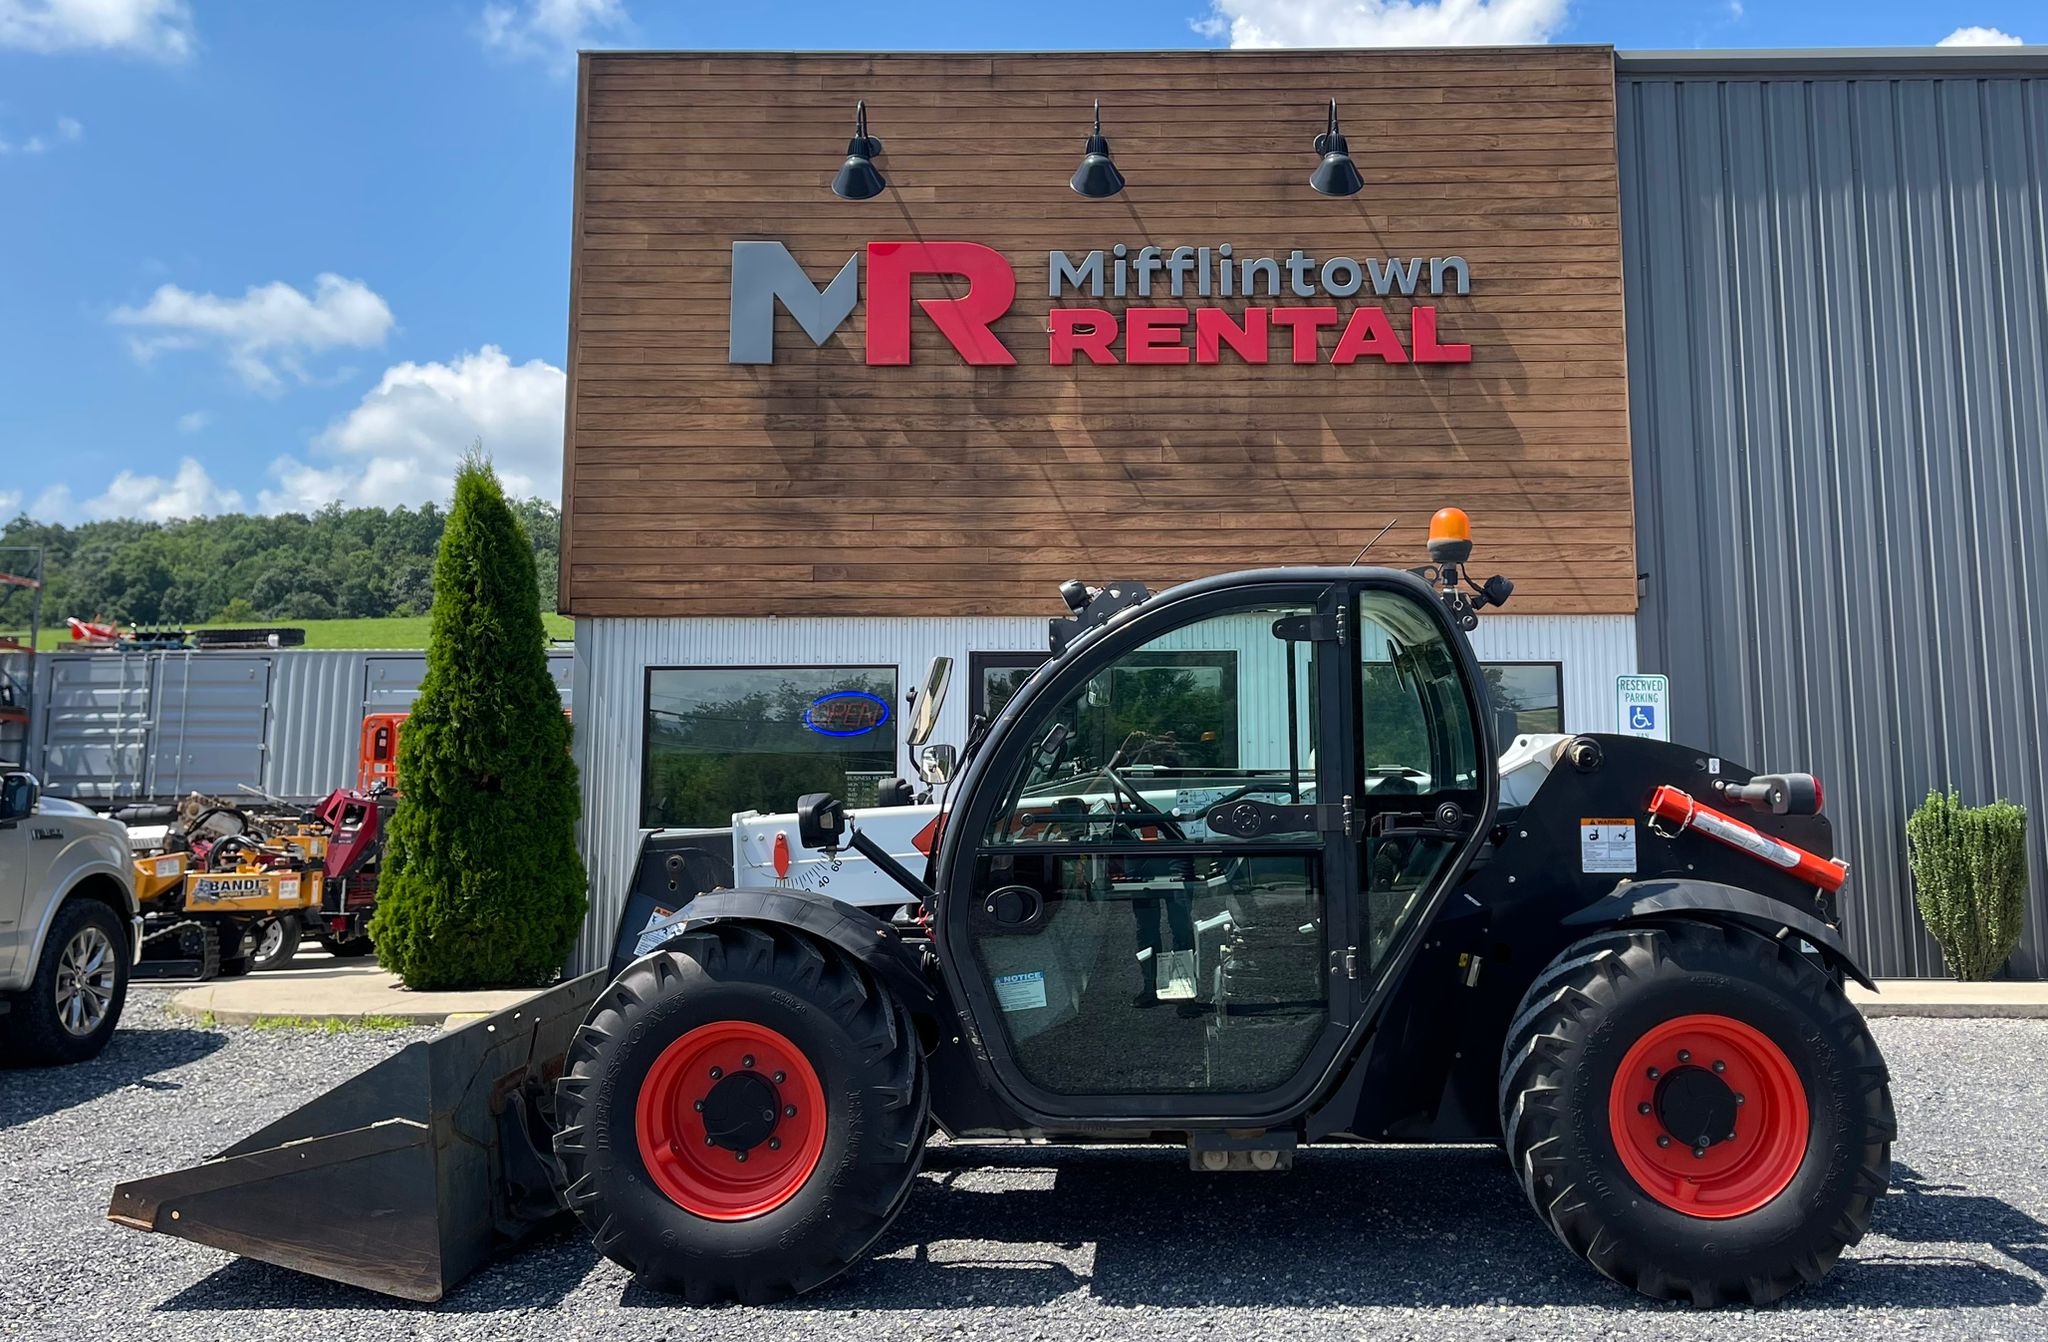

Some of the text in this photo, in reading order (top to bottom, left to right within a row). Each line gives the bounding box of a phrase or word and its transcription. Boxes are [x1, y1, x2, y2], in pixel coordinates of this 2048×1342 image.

[1049, 243, 1471, 298] Mifflintown
[729, 241, 1017, 366] MR
[1049, 305, 1473, 366] RENTAL
[1620, 679, 1663, 691] RESERVED
[1625, 693, 1659, 703] PARKING
[811, 702, 881, 726] OPEN
[831, 860, 842, 872] 60
[819, 876, 830, 888] 40
[1003, 971, 1042, 982] NOTICE
